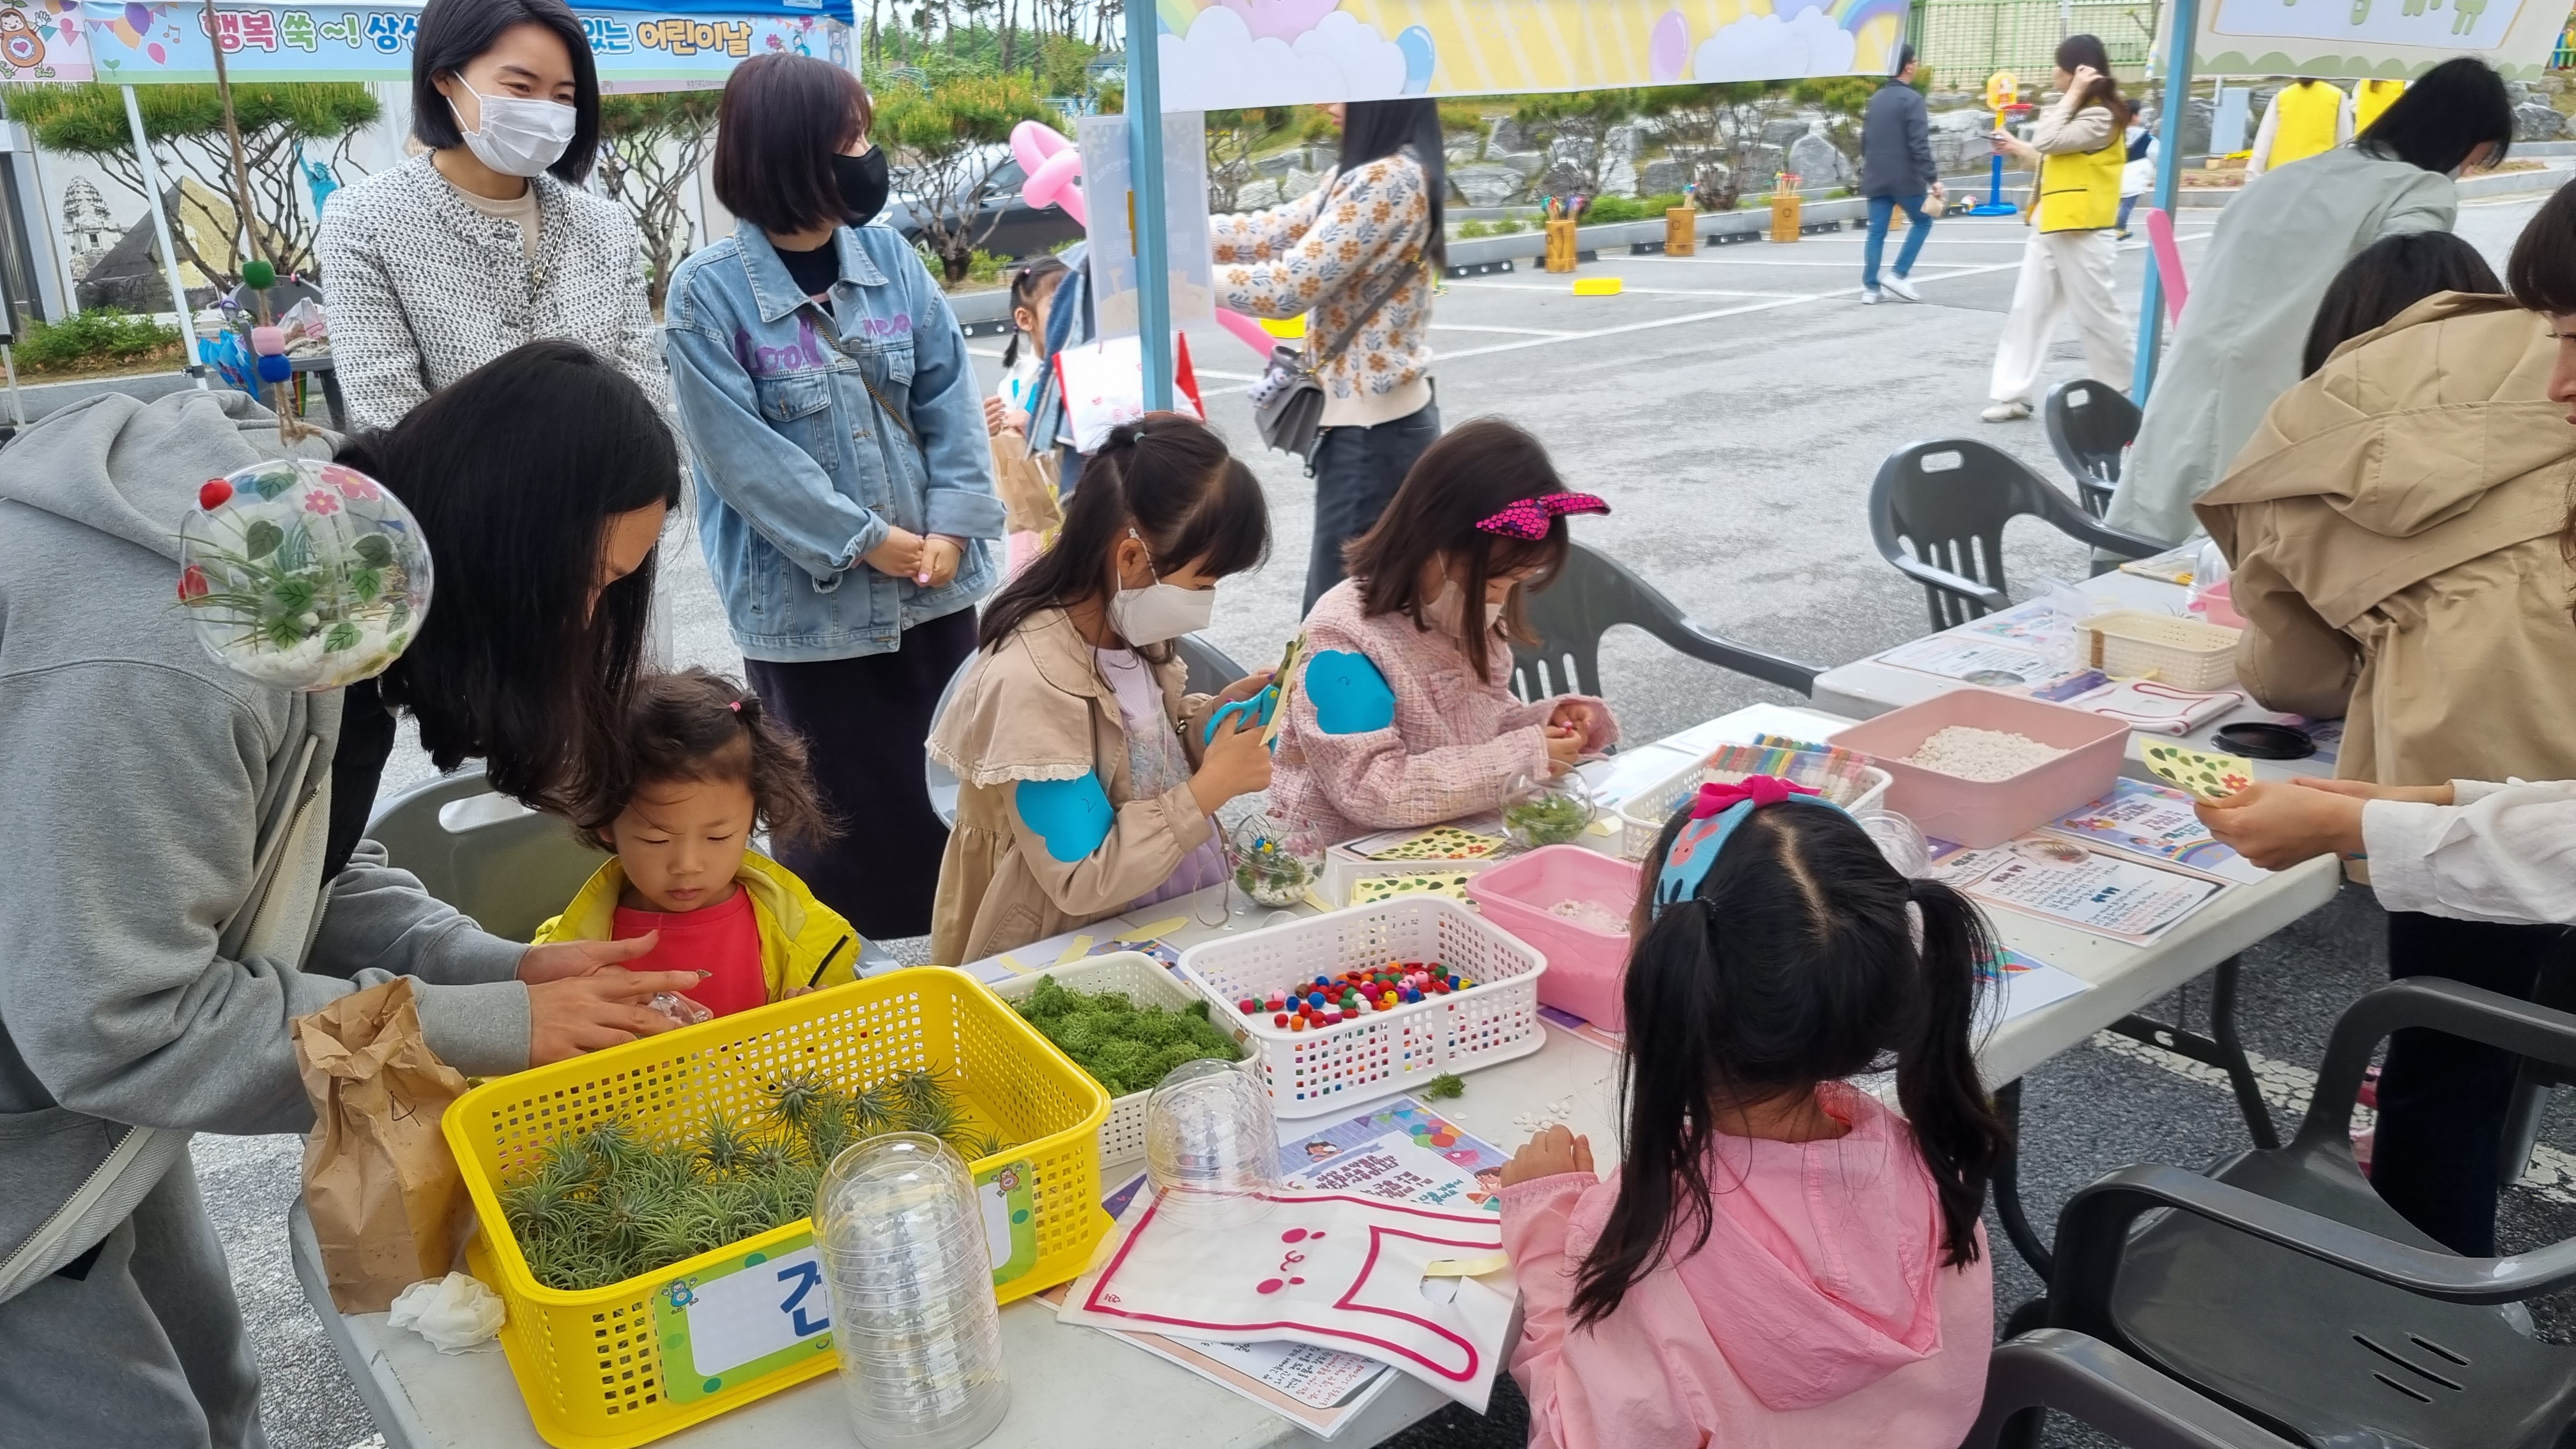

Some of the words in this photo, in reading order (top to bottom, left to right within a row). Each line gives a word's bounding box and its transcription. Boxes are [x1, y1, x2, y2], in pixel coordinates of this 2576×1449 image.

[201, 13, 275, 50] 행복
[283, 14, 314, 49] 쑥
[579, 19, 630, 51] 있는
[639, 20, 752, 57] 어린이날
